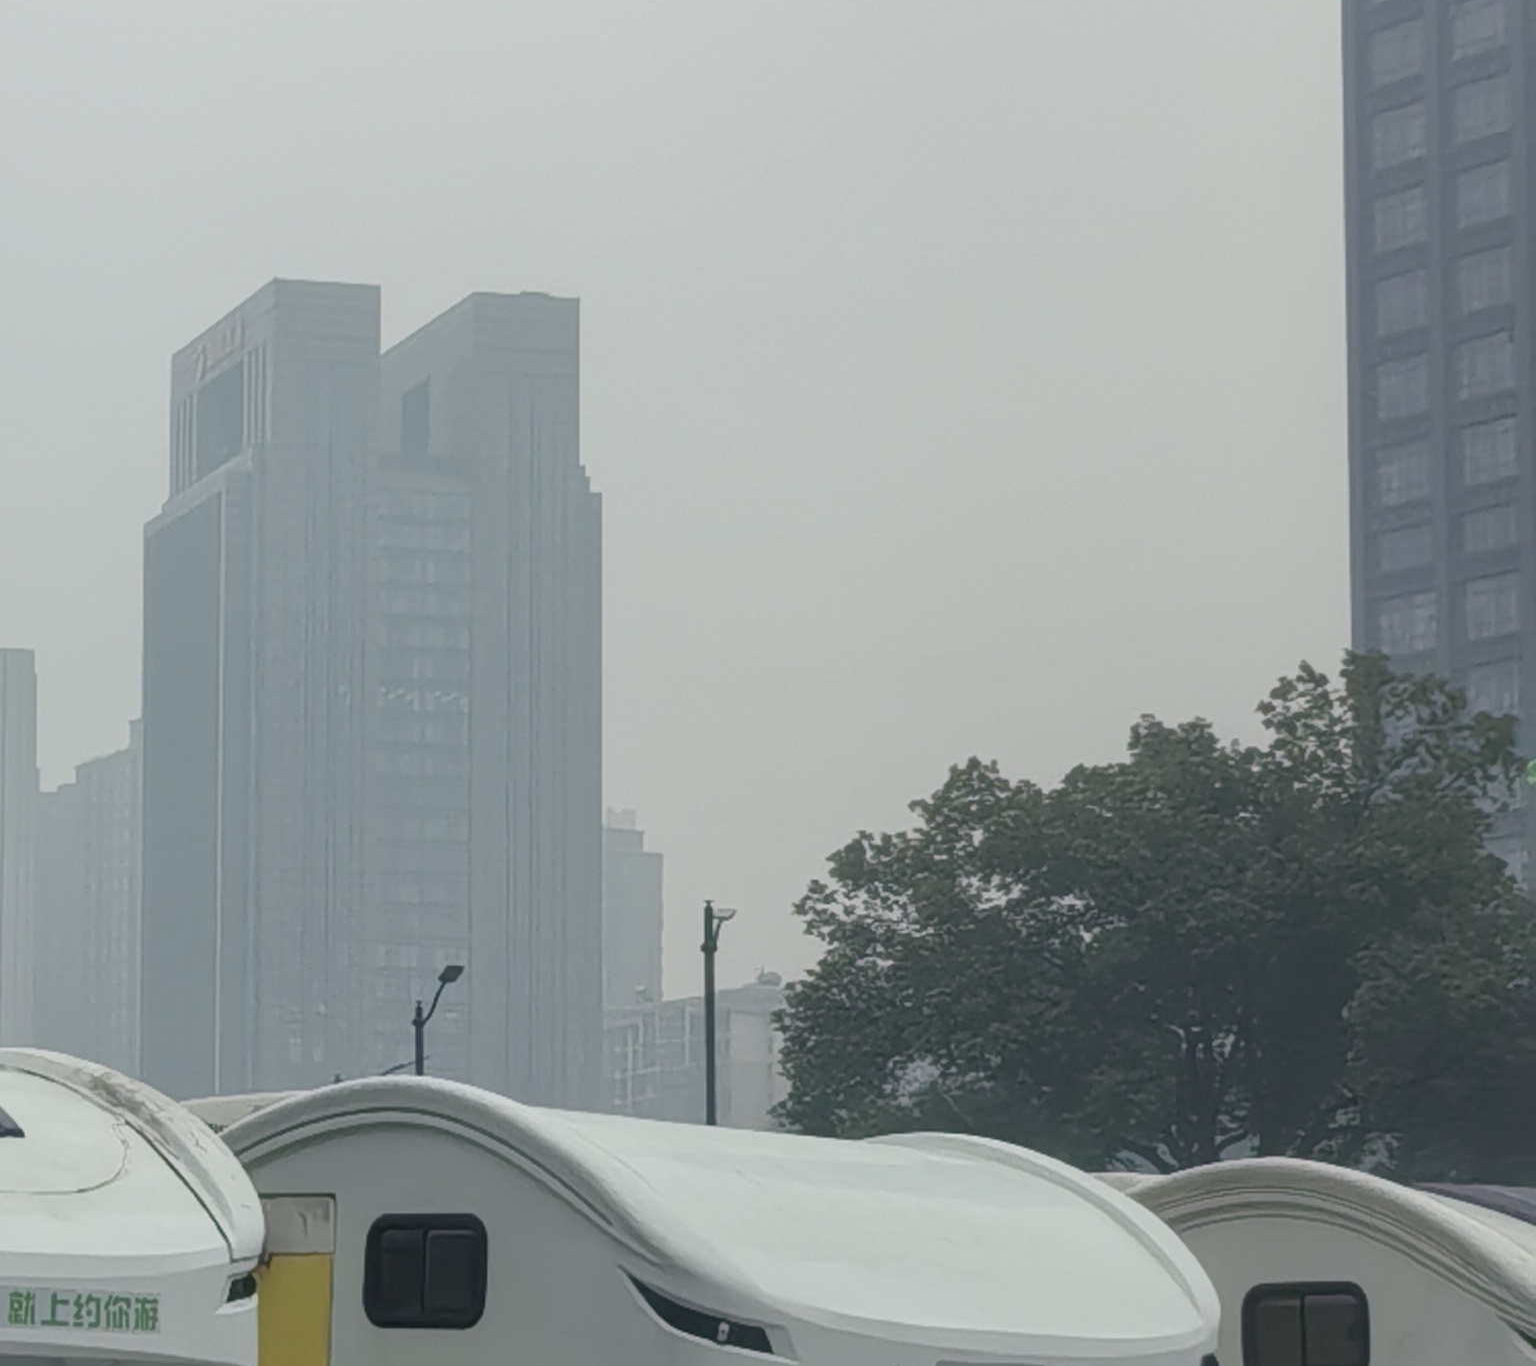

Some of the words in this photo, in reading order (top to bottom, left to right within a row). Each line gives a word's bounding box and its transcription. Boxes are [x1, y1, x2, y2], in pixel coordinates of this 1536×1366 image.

[7, 1291, 160, 1333] 就上约你游
